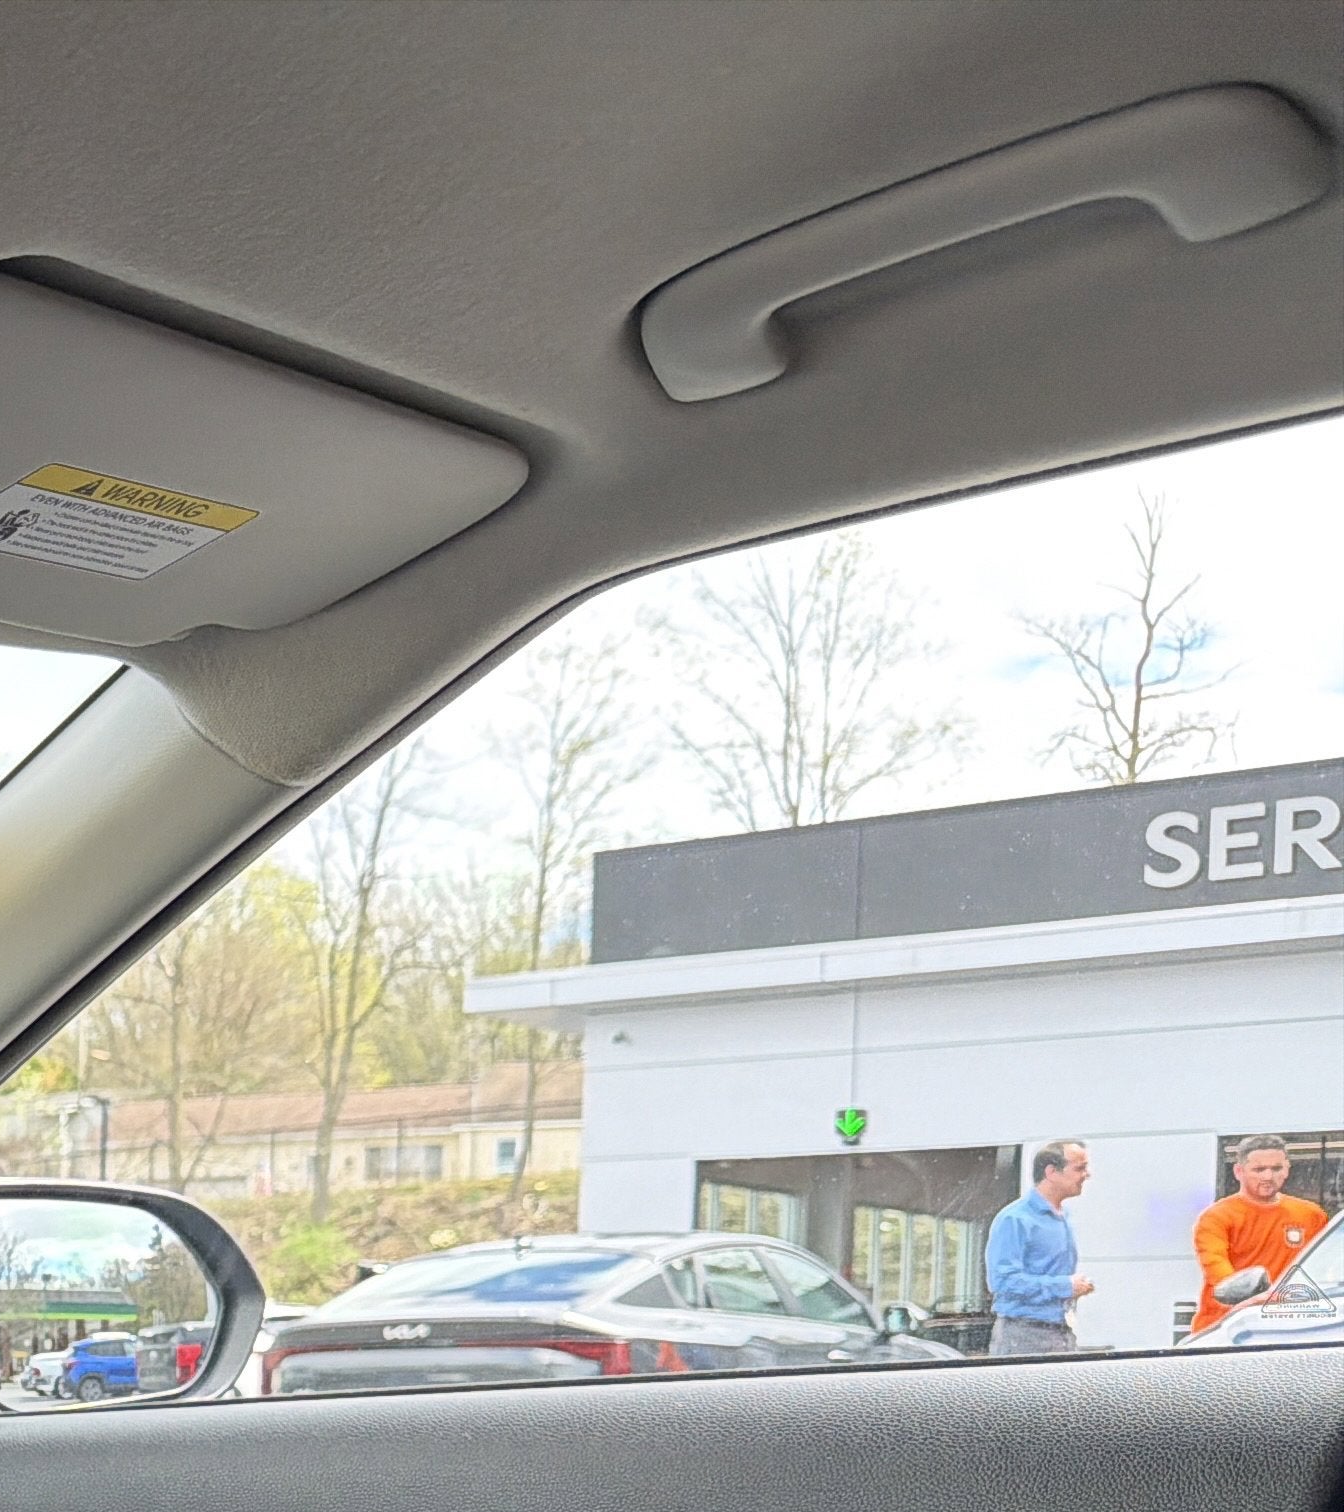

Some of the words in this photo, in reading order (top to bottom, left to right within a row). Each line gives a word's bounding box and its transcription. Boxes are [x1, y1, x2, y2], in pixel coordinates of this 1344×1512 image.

[30, 494, 62, 507] EVEN
[61, 500, 91, 514] WITH
[90, 505, 149, 526] ADVANCED
[145, 519, 166, 531] AIR
[162, 524, 196, 537] BAGS
[101, 484, 210, 518] WARNING
